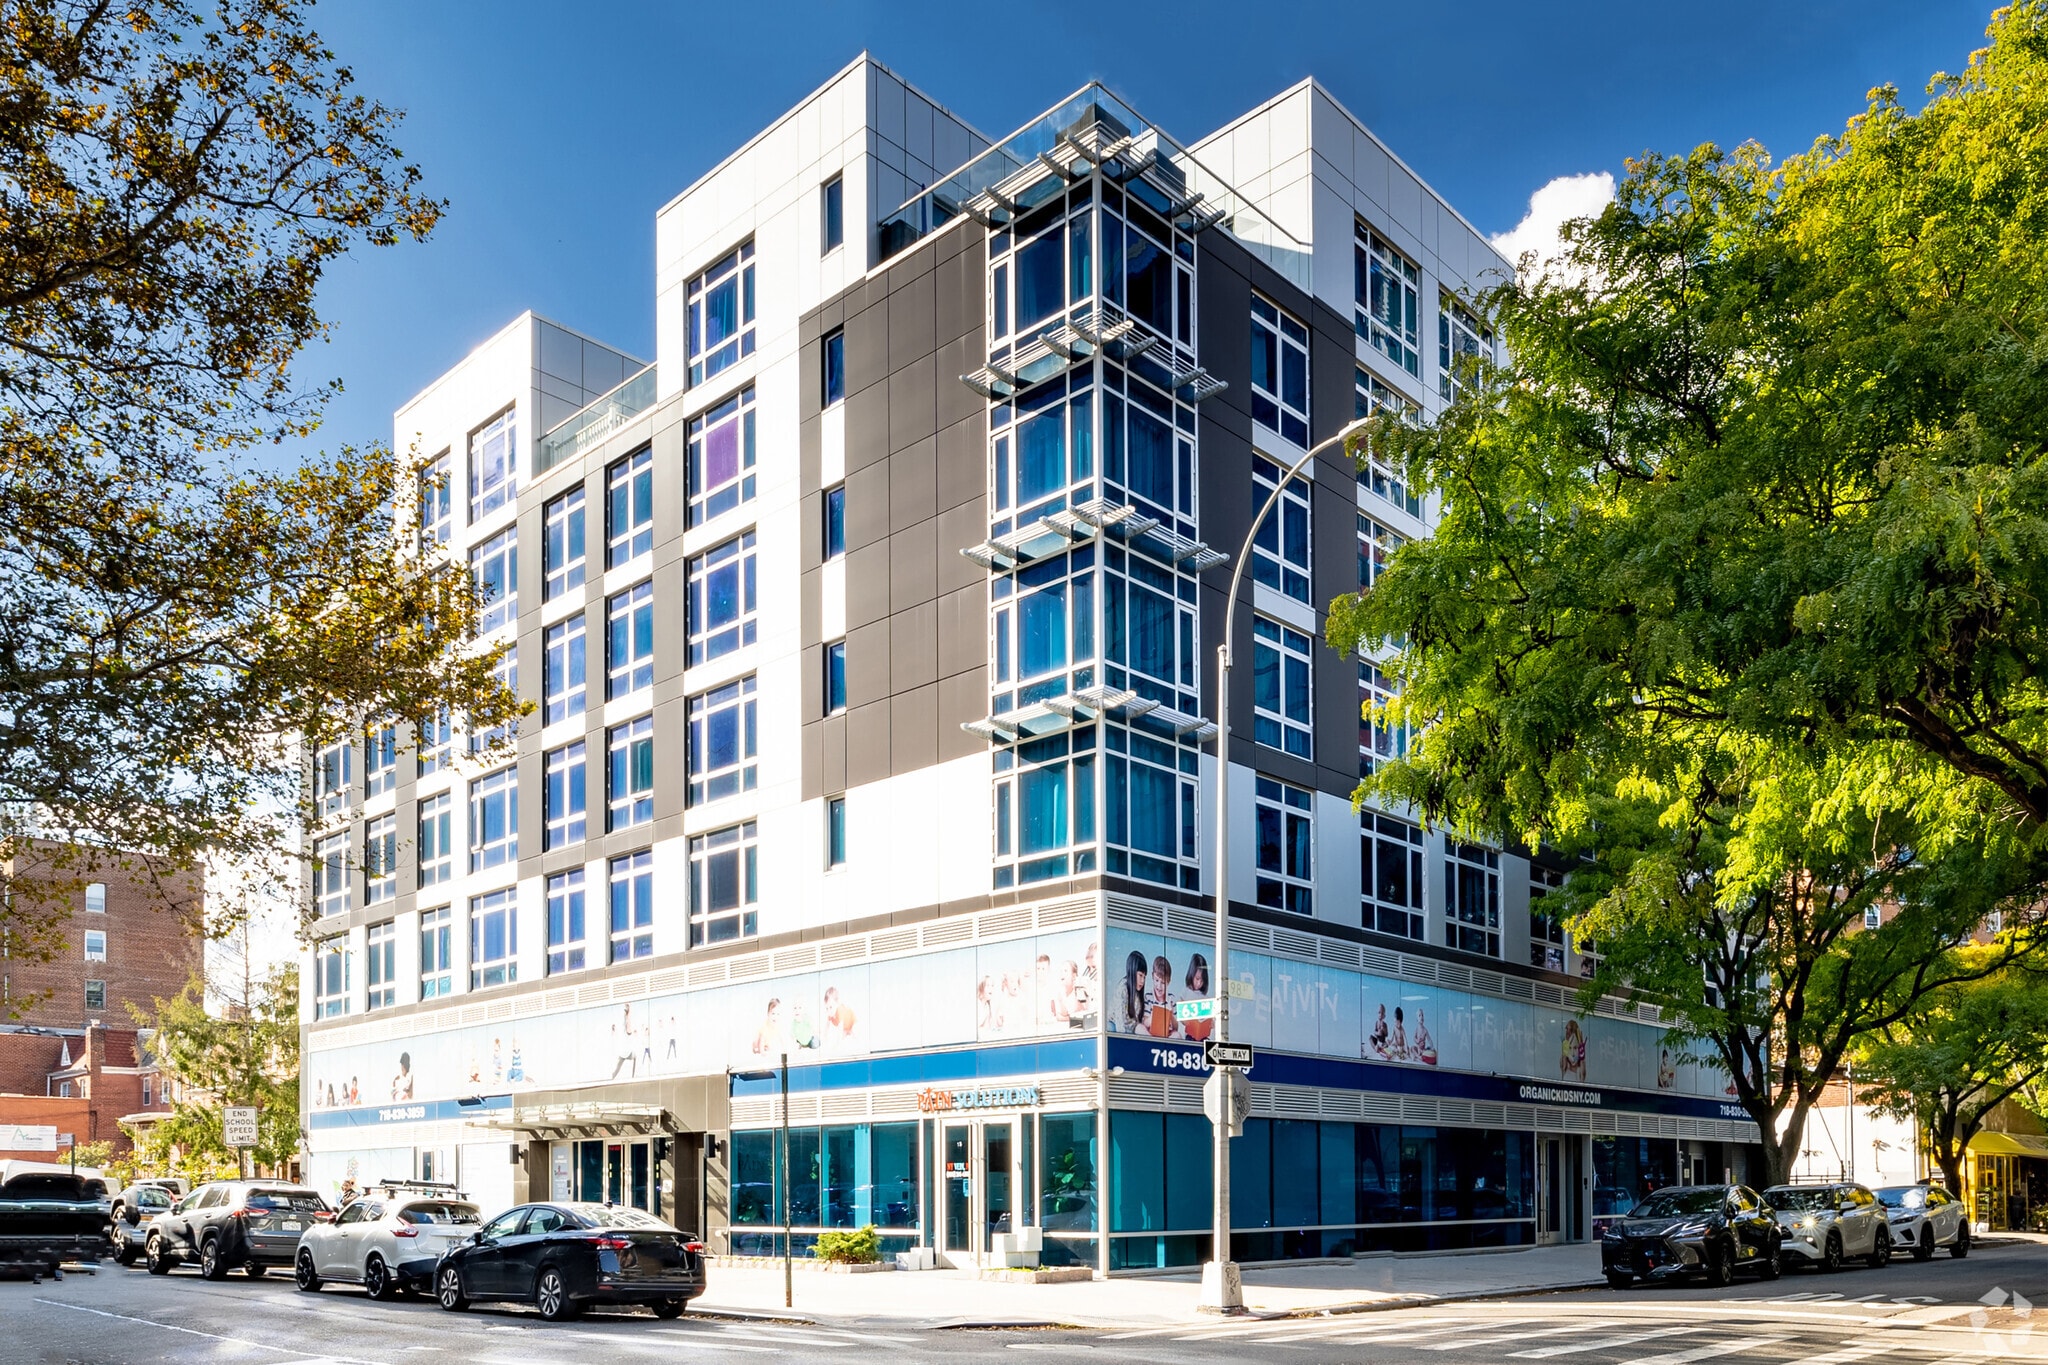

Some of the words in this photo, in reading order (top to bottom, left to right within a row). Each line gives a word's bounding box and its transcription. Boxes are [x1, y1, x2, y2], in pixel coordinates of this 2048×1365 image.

[1181, 1002, 1199, 1018] 63
[1201, 1001, 1211, 1010] DR
[1212, 1048, 1226, 1059] ONE
[1232, 1049, 1247, 1060] WAY
[916, 1087, 952, 1112] PAIN
[956, 1086, 1040, 1110] SOLUTIONS
[1519, 1085, 1601, 1105] ORGANICKIDSNY.COM
